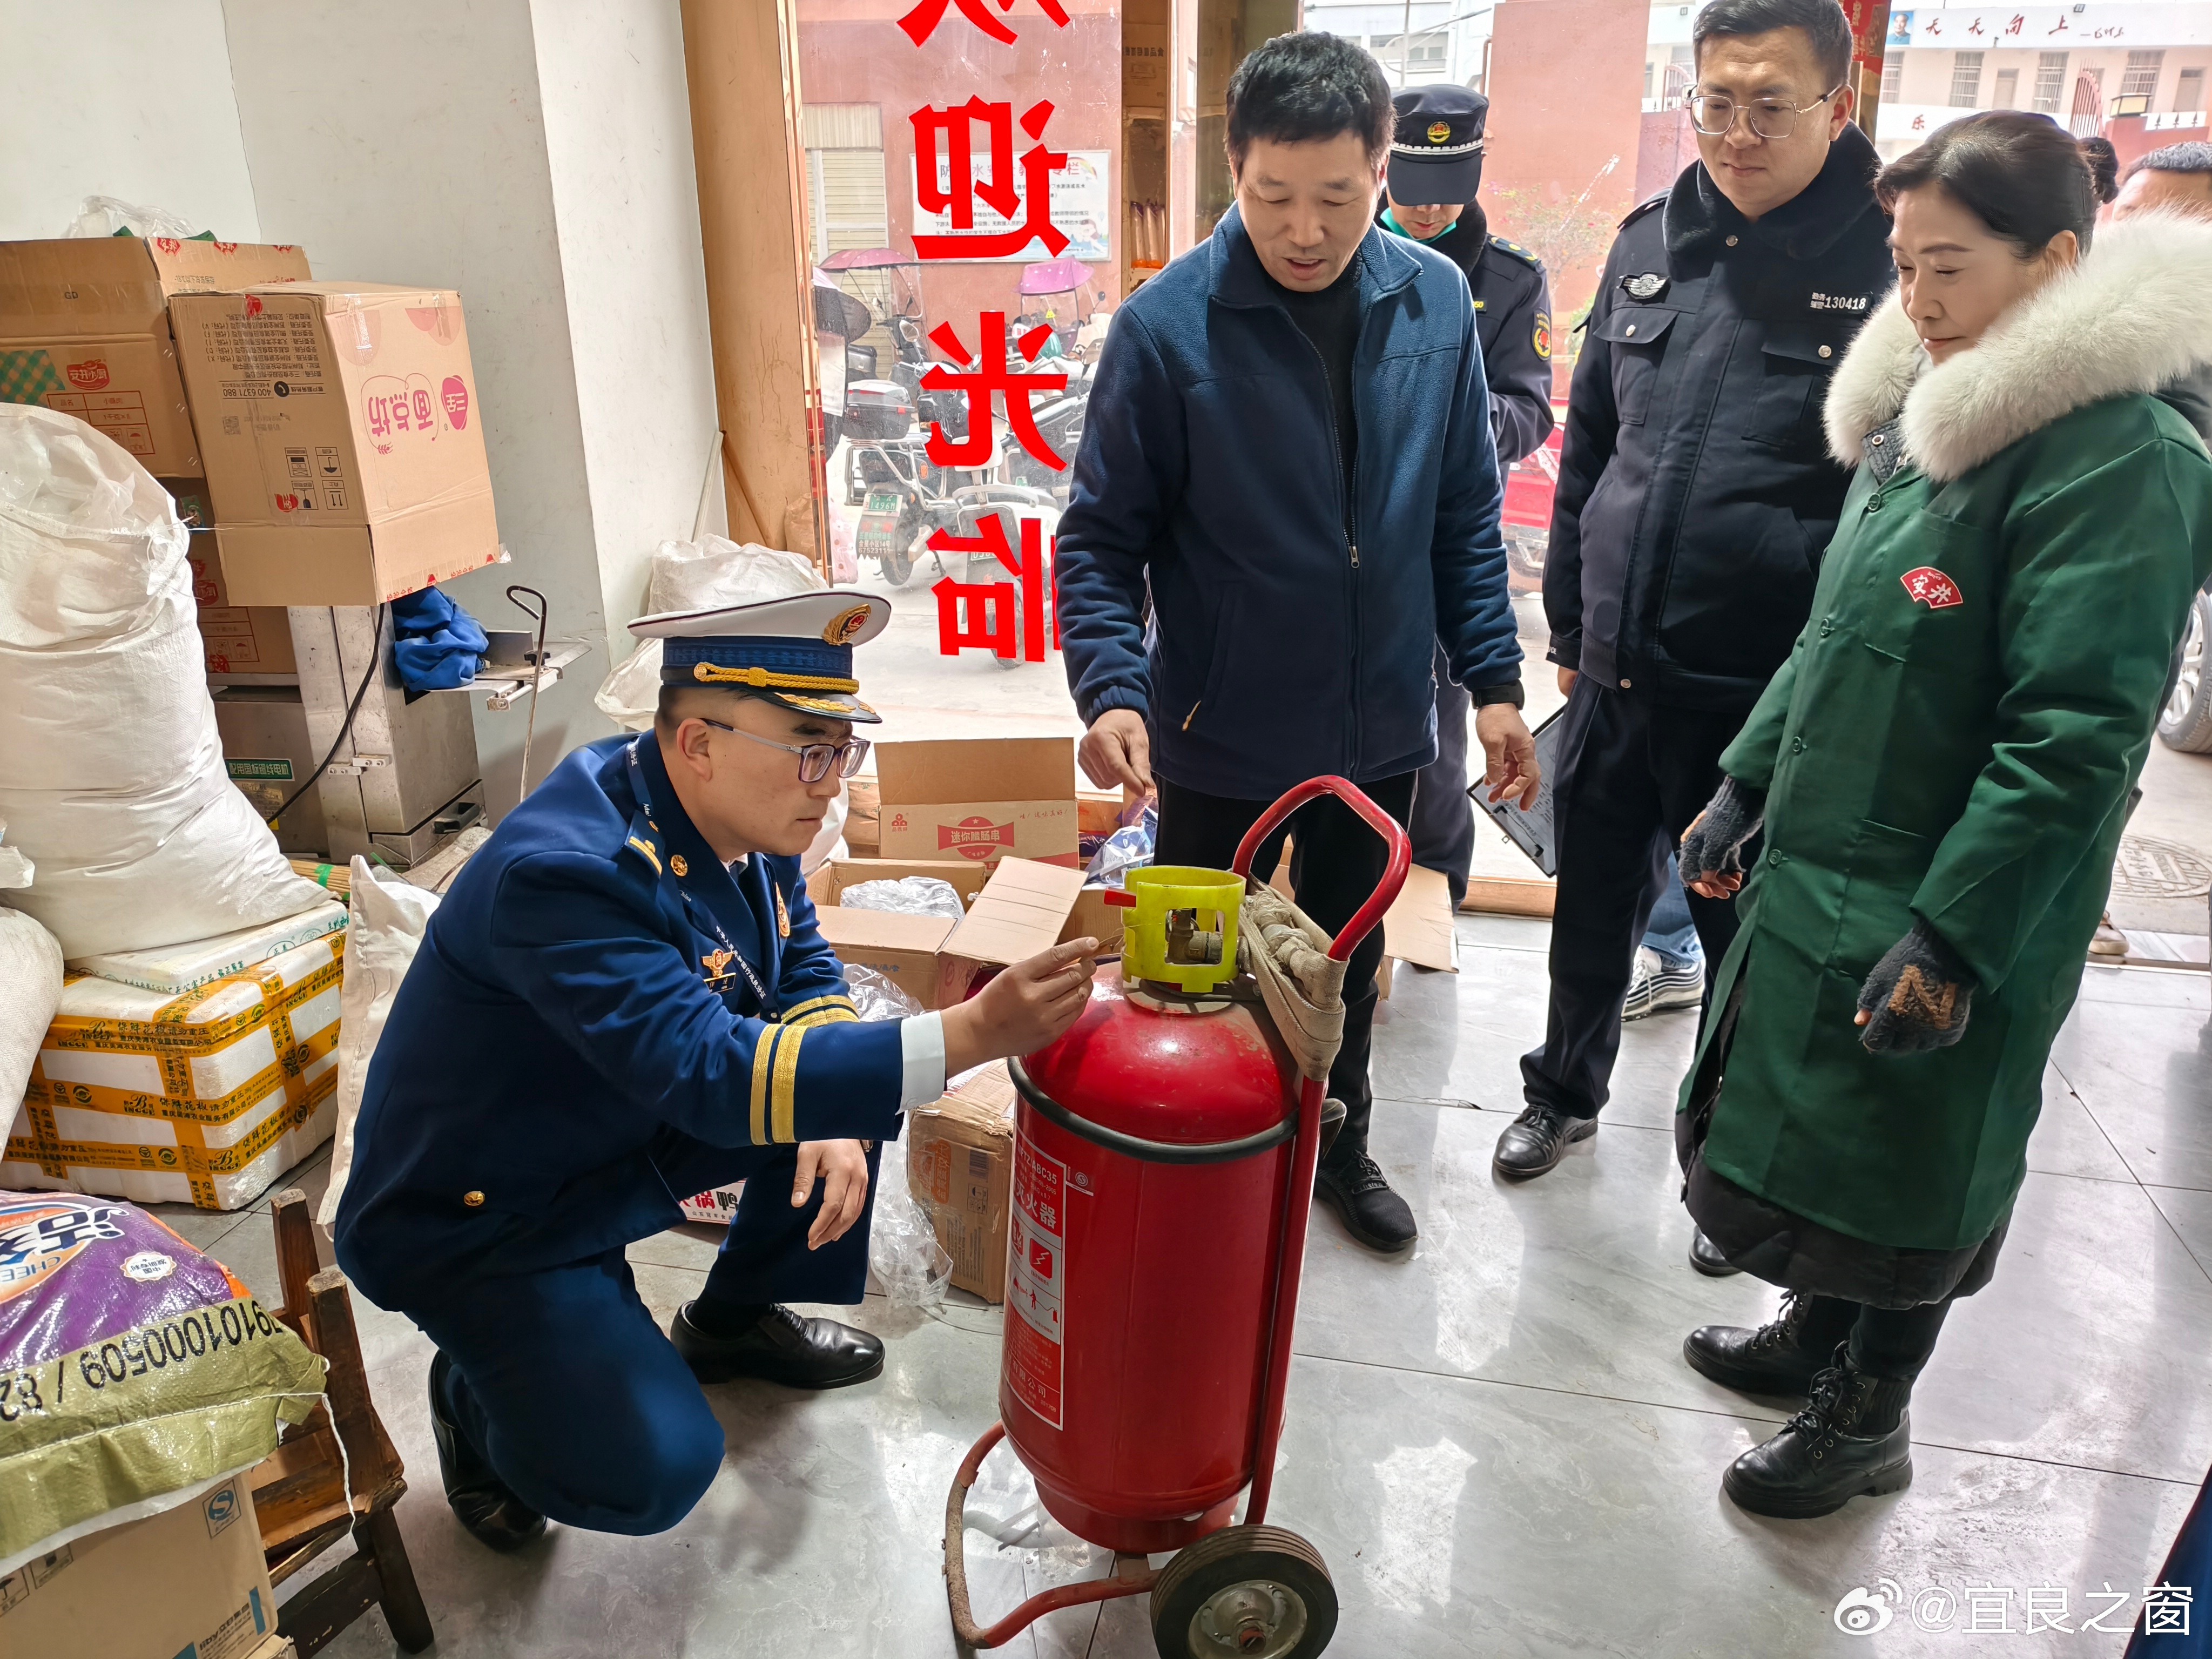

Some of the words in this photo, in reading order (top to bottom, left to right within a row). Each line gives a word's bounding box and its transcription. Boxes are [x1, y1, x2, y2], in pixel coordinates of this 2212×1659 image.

[1926, 14, 2068, 35] 天天向上
[64, 291, 78, 299] GD
[1824, 296, 1867, 310] 130418
[222, 388, 237, 397] 880
[239, 388, 257, 396] 6371
[258, 388, 271, 396] 400
[368, 390, 433, 437] 面点坊
[870, 502, 896, 510] 1496M
[950, 829, 1000, 844] 迷你腊肠串
[716, 925, 766, 1000] 中华人民共和国行政执法证
[1016, 1177, 1057, 1229] 灭火器
